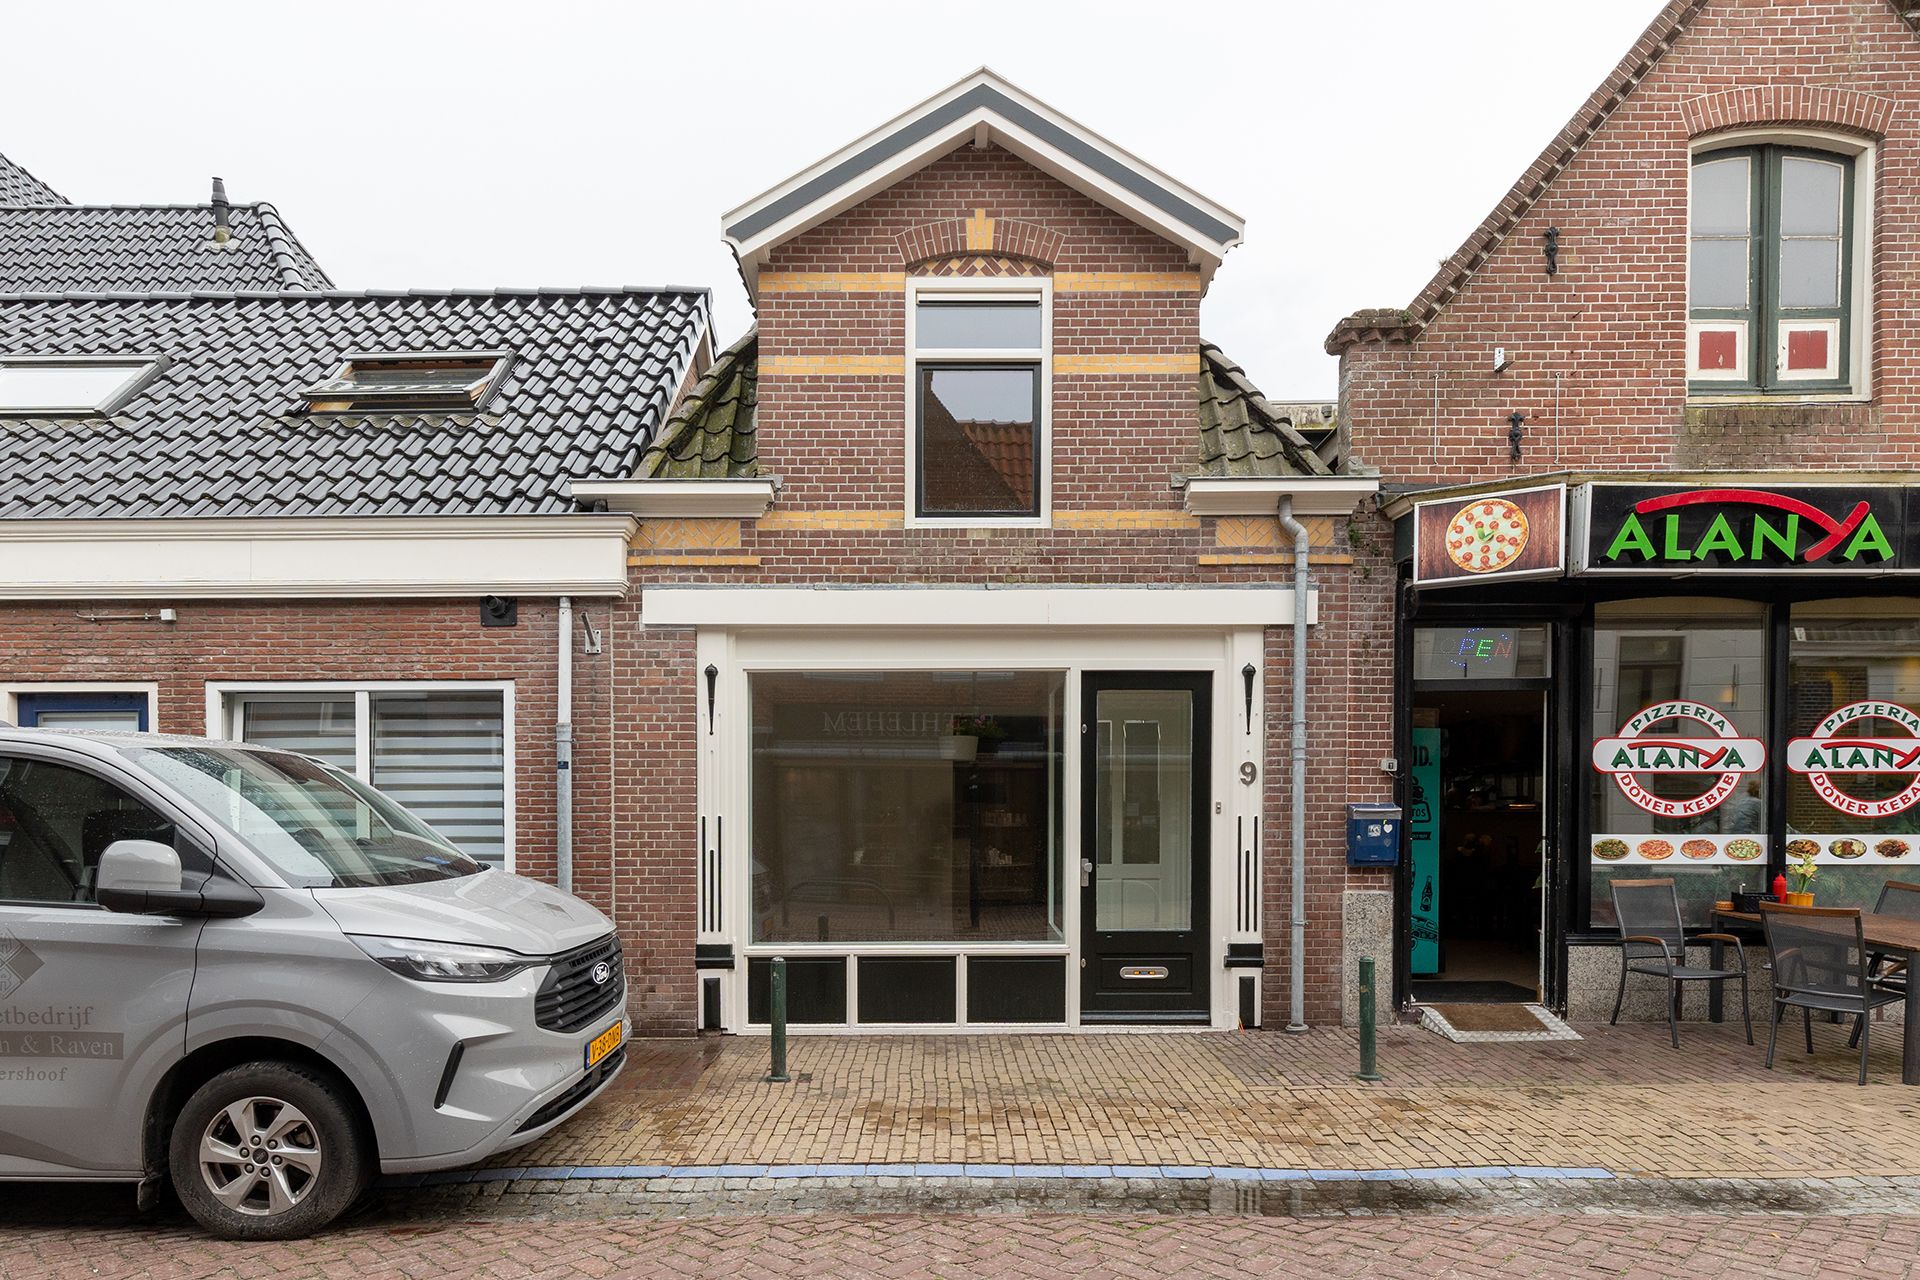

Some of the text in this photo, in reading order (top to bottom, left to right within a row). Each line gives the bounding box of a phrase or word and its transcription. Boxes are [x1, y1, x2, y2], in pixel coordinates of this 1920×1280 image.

[1606, 489, 1895, 562] ALANYA
[1630, 704, 1727, 732] PIZZERIA
[1823, 704, 1920, 732] PIZZERIA
[1611, 741, 1745, 769] ALANYA
[1804, 741, 1920, 769] ALANY
[1240, 761, 1257, 787] 9
[1620, 774, 1734, 814] DÖNER KEBAB
[1813, 774, 1920, 814] DÖNER KEBA
[20, 1034, 41, 1054] &
[50, 1035, 113, 1056] Raven
